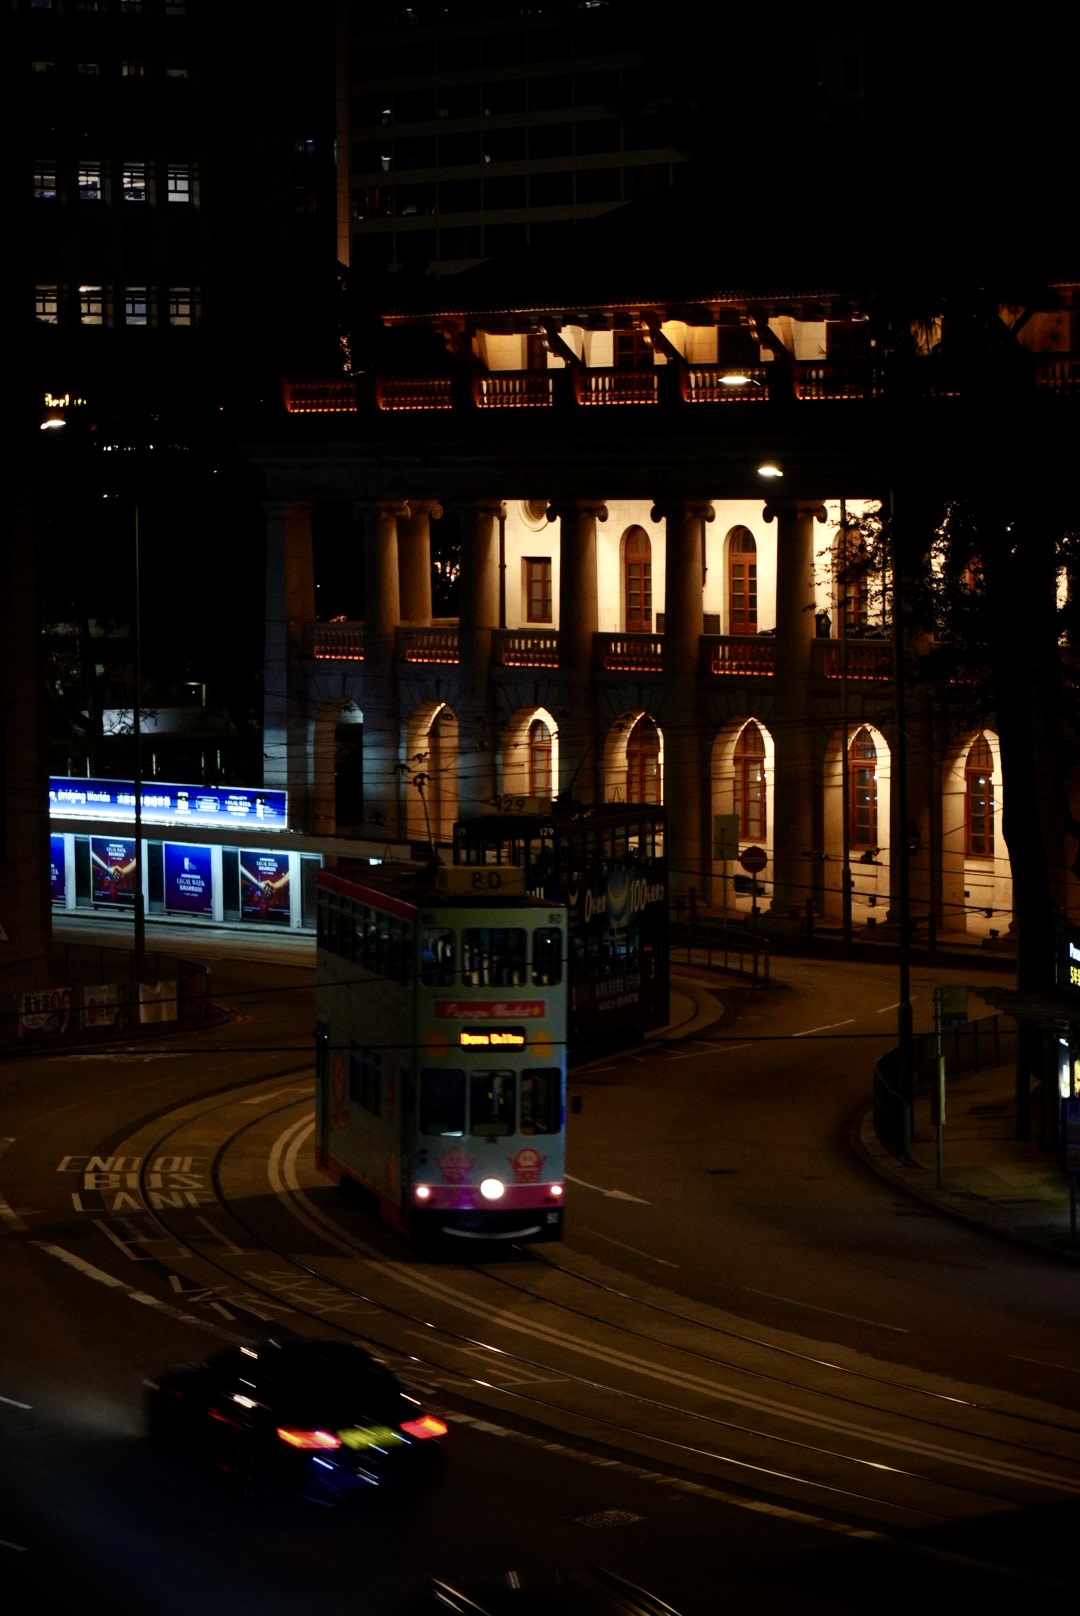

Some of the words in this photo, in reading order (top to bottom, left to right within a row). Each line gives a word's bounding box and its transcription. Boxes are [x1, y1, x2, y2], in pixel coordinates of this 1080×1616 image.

[540, 828, 554, 837] 129
[472, 871, 501, 890] 80
[56, 1155, 142, 1172] END
[152, 1155, 209, 1172] OF
[84, 1173, 205, 1190] BUS
[71, 1191, 218, 1212] LANE
